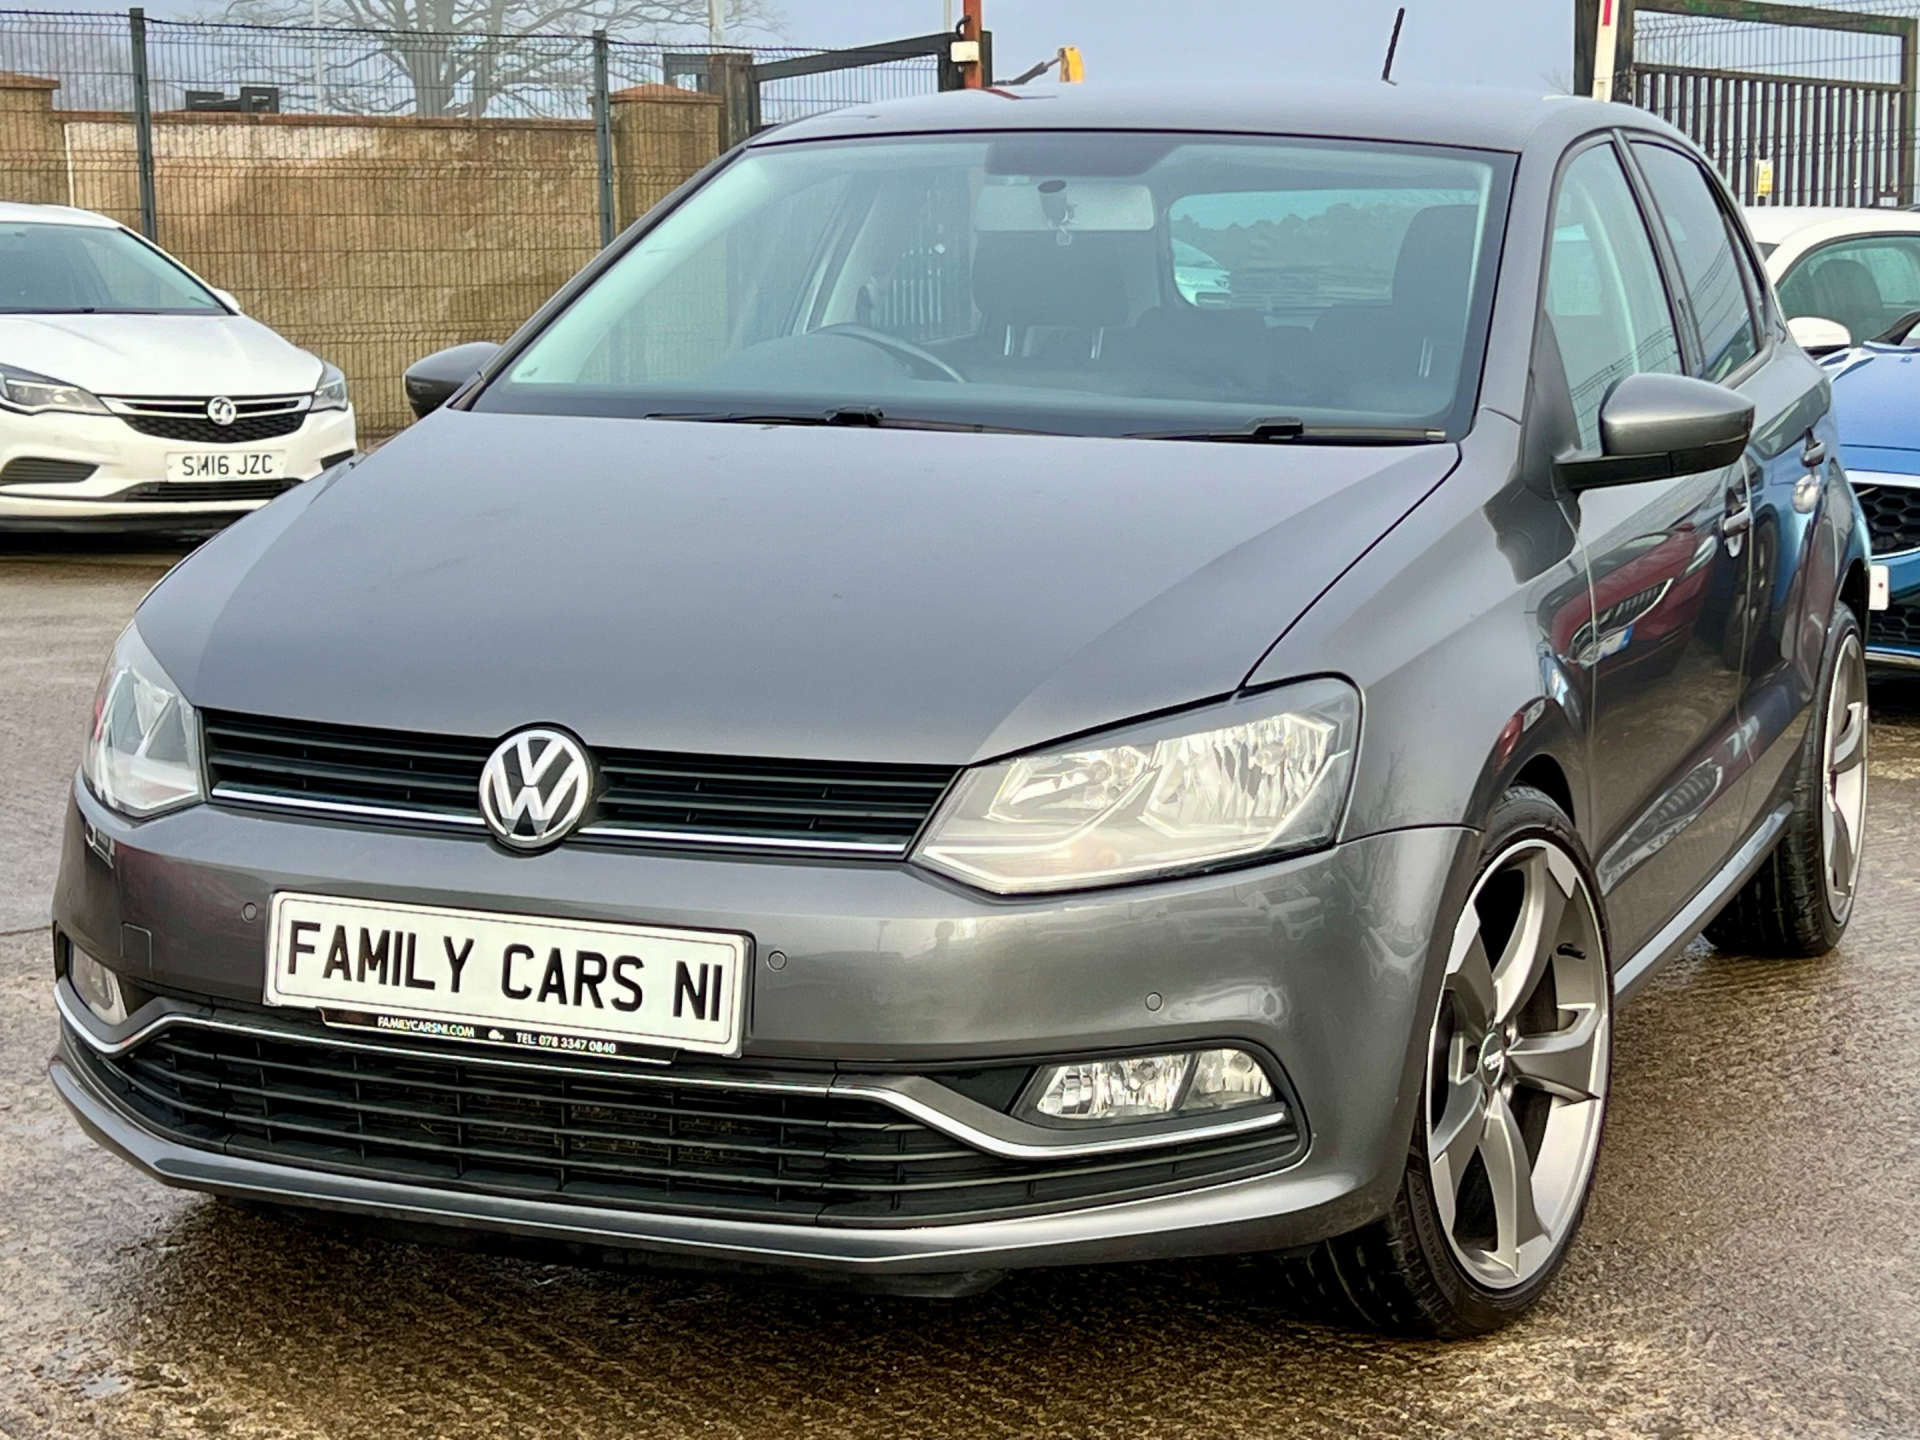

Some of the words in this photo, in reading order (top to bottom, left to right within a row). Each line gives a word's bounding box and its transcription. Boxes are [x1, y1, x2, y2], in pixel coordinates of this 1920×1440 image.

[182, 454, 230, 477] SM16
[237, 454, 273, 476] JZC
[483, 729, 589, 841] VW
[287, 919, 474, 993] FAMILY
[501, 943, 644, 1012] CARS
[673, 960, 723, 1022] NI
[377, 1015, 475, 1038] FAMILYCARSNI.COM
[516, 1032, 537, 1045] TEL:
[538, 1035, 559, 1048] 078
[560, 1037, 587, 1051] 3347
[588, 1041, 617, 1054] 0840
